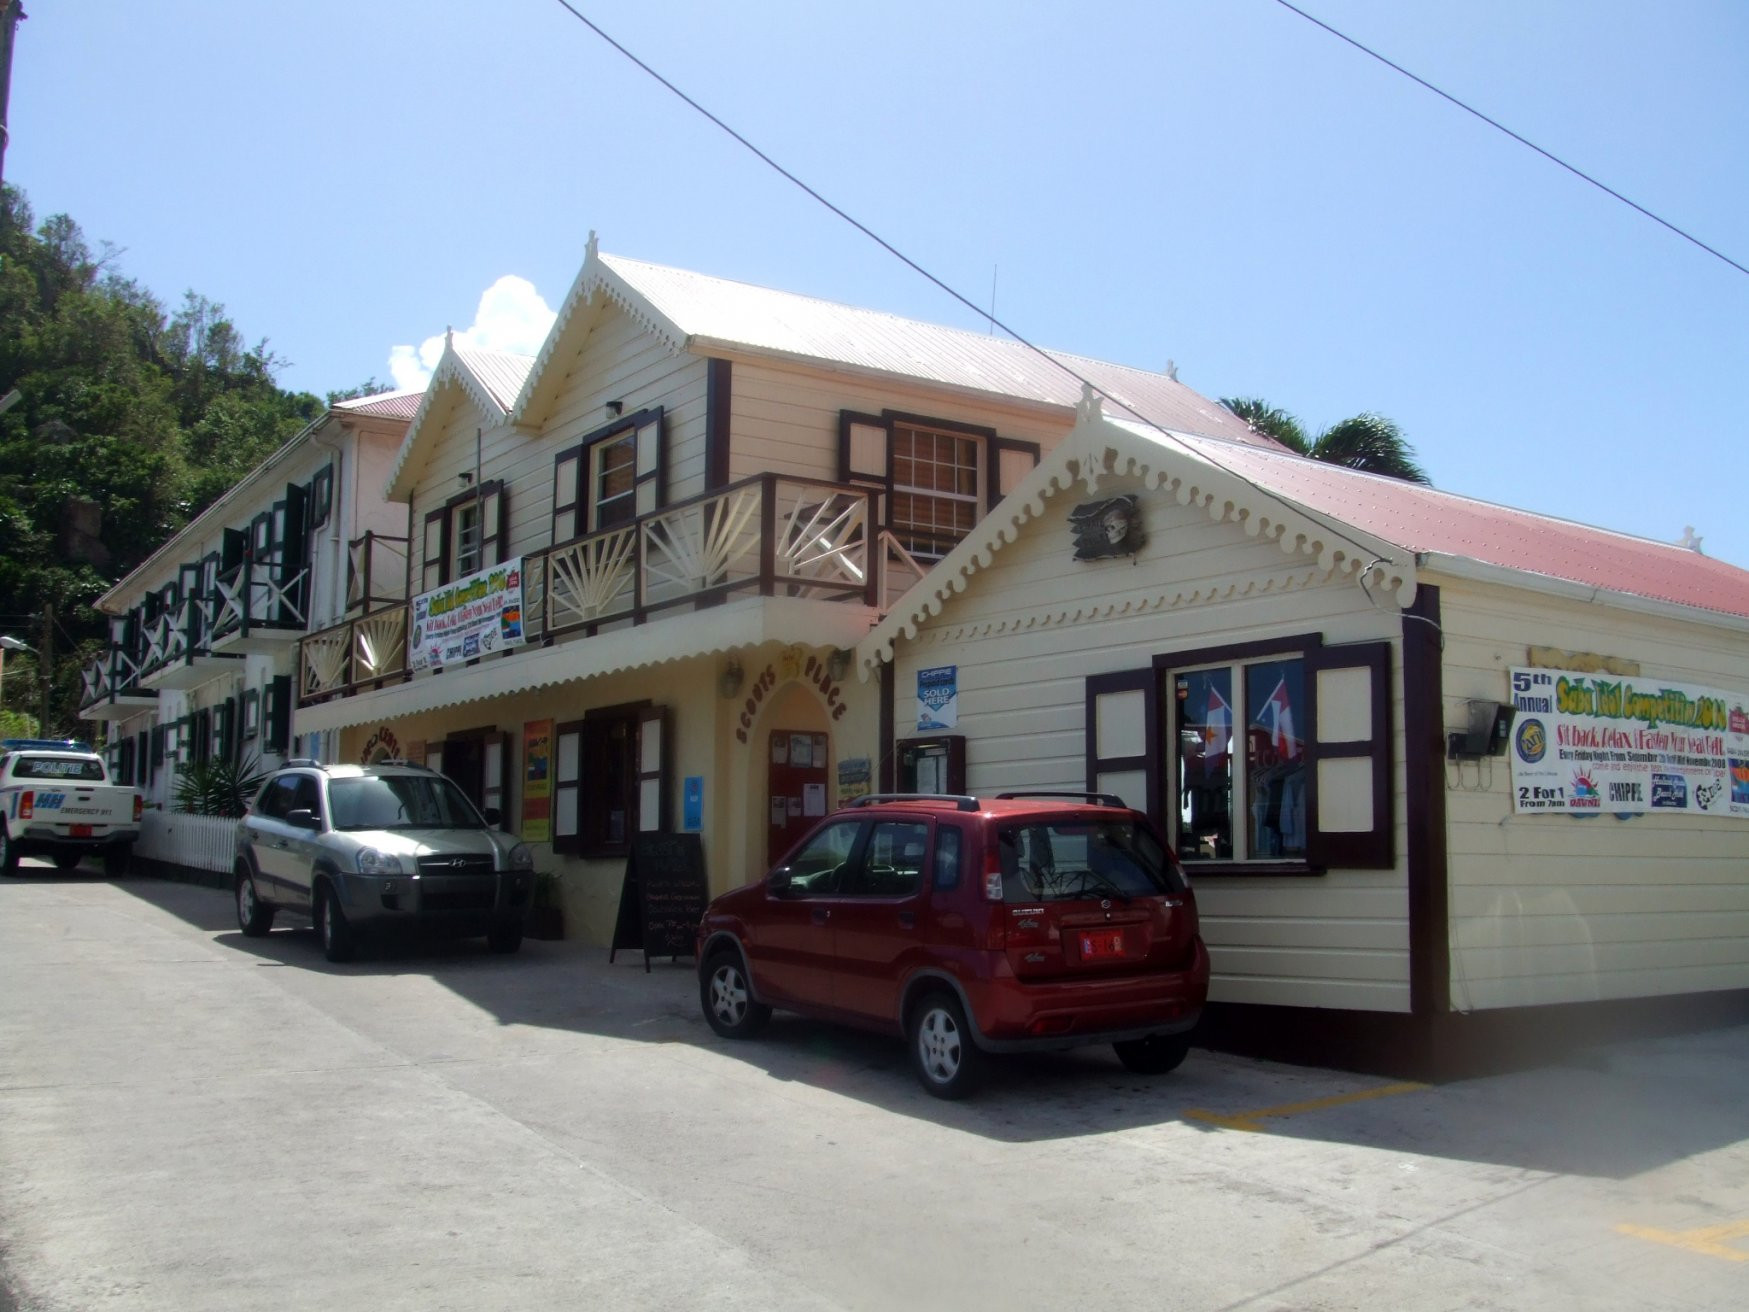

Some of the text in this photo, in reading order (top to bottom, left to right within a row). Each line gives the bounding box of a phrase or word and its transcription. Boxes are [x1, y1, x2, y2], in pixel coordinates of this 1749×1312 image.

[804, 656, 847, 721] PLACE
[1513, 672, 1552, 692] 5th
[924, 688, 950, 698] SOLD
[924, 696, 952, 705] HERE
[1556, 676, 1594, 716] Saba
[1514, 693, 1553, 714] Annual
[1557, 724, 1570, 746] Sit
[1602, 727, 1633, 749] Relax
[31, 761, 83, 774] POLITIE
[1574, 750, 1592, 761] Friday
[1610, 751, 1626, 761] From
[1627, 751, 1658, 763] September
[1711, 757, 1726, 769] 2008
[1519, 786, 1564, 799] 2 For 1
[60, 807, 113, 816] EMERGENCY 911
